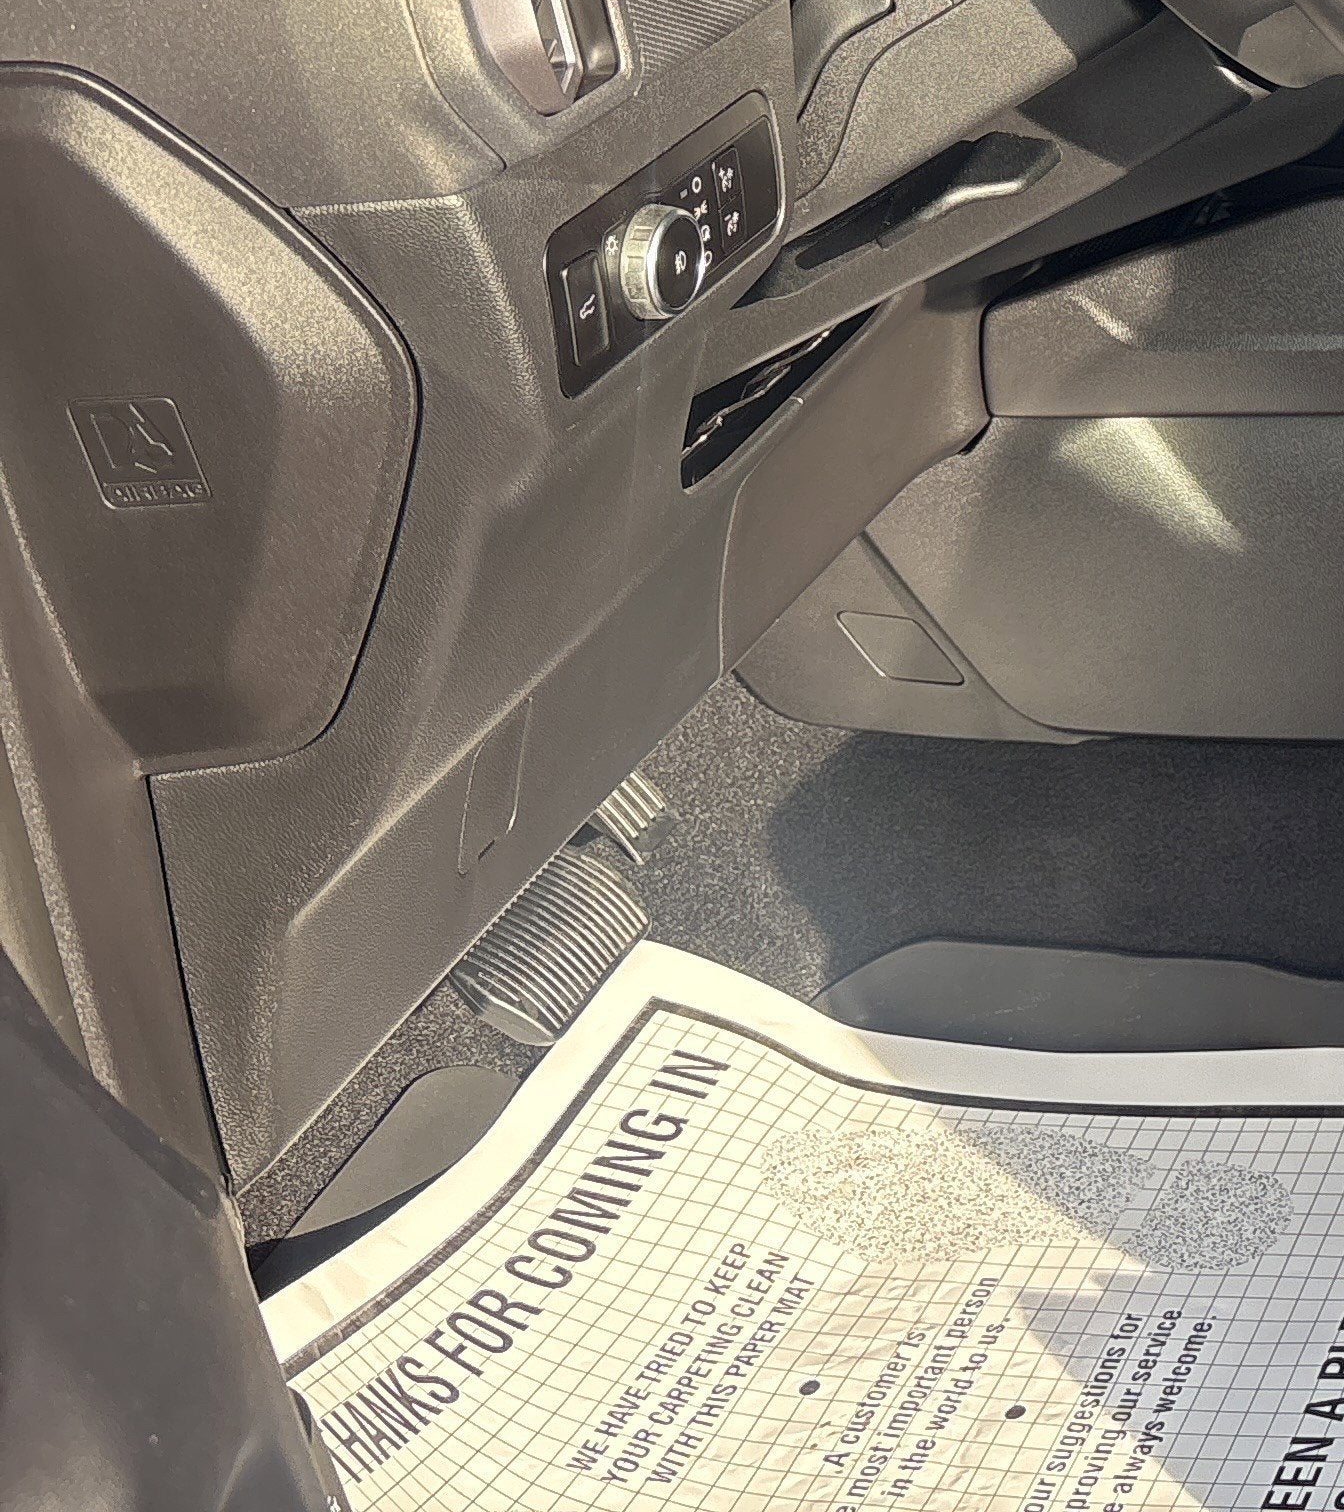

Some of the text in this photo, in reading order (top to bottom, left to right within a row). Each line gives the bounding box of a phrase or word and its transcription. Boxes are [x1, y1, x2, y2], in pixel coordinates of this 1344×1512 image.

[425, 1289, 544, 1376] FOR
[505, 1108, 690, 1290] COMING
[648, 1049, 732, 1101] IN
[565, 1242, 751, 1472] WE HAVE TRIED TO KEEP
[600, 1251, 790, 1483] YOUR CARPETING CLEAN
[645, 1273, 815, 1484] WITH THIS PAPER MAT
[840, 1352, 911, 1444] customer
[846, 1441, 894, 1498] most
[877, 1344, 957, 1438] important
[945, 1276, 999, 1340] person
[880, 1317, 1012, 1498] in the world to us.
[1023, 1481, 1057, 1512] our
[1046, 1346, 1125, 1472] suggestions
[1117, 1312, 1144, 1340] for
[1065, 1428, 1127, 1512] proving
[1111, 1387, 1143, 1422] our
[1131, 1308, 1182, 1385] service
[1118, 1314, 1217, 1494] always welcome.
[1261, 1437, 1335, 1510] EEN
